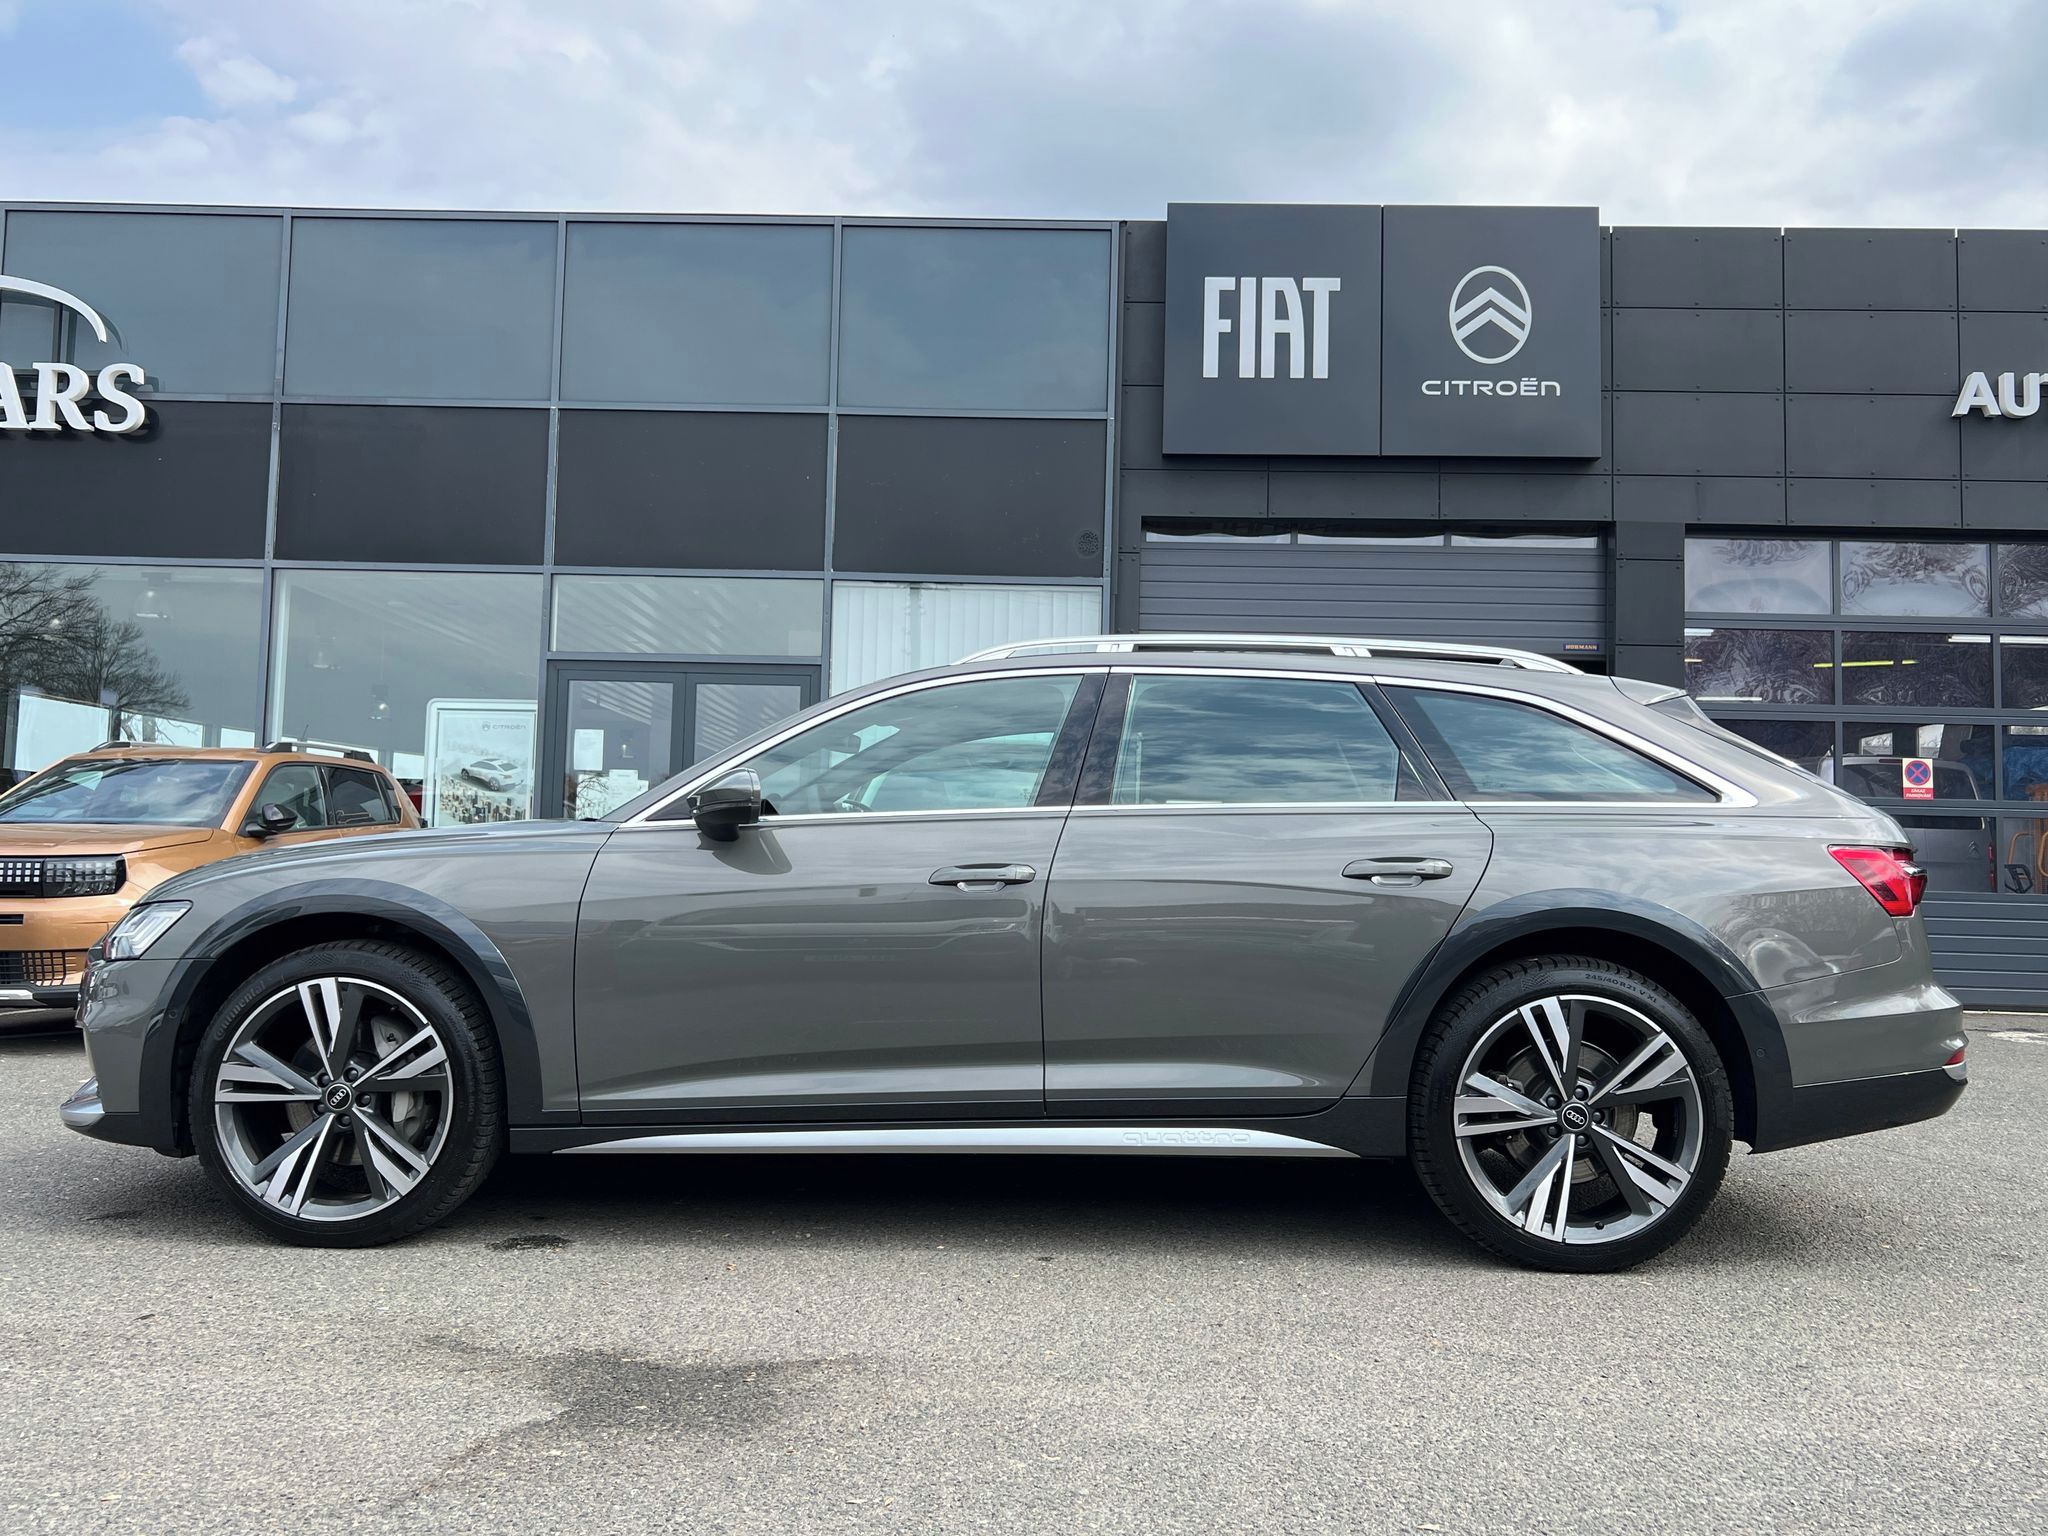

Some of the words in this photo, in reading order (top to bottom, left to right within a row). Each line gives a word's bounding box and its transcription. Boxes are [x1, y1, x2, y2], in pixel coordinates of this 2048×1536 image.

[1202, 276, 1341, 379] FIAT
[1421, 377, 1561, 397] CITROËN
[1122, 1130, 1250, 1146] quattro
